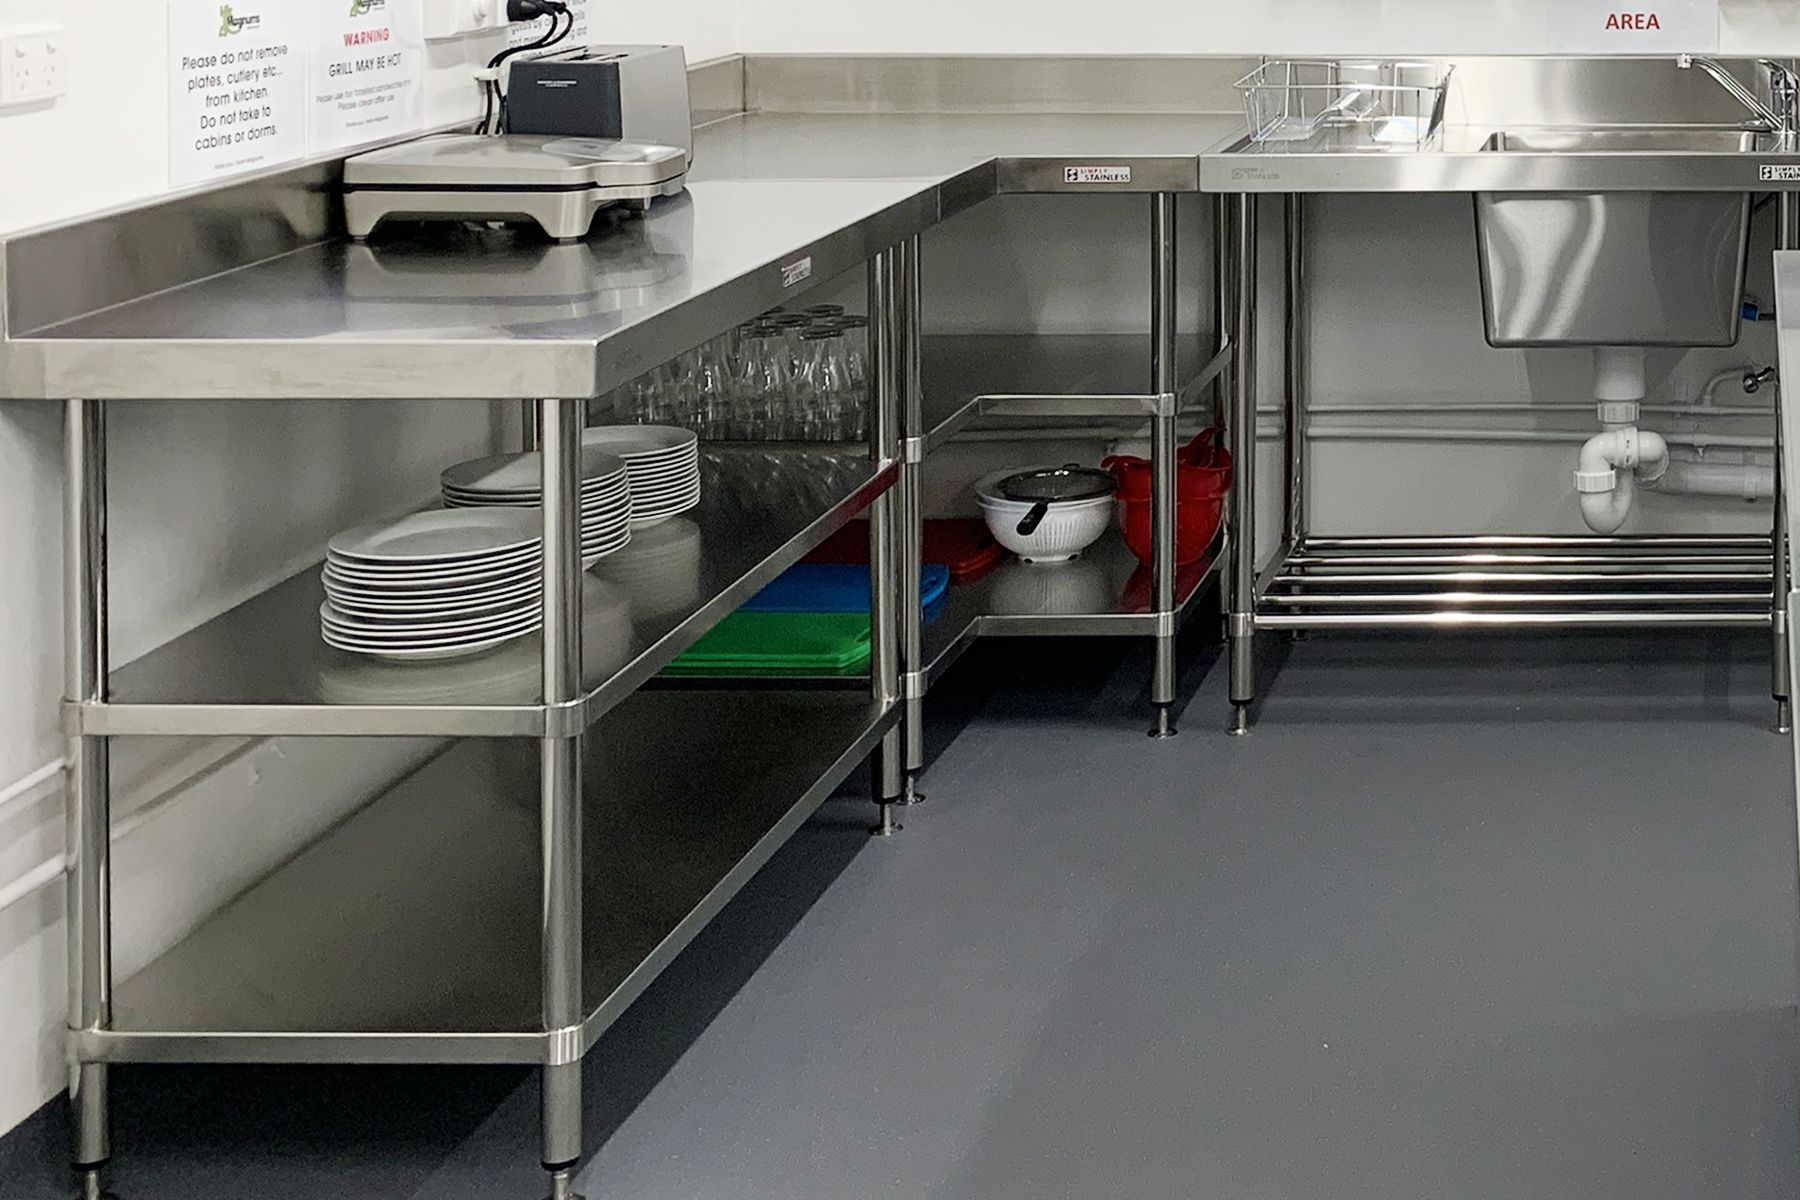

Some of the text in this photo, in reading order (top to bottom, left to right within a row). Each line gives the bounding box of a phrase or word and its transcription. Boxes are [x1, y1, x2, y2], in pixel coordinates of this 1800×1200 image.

[1605, 14, 1660, 30] AREA
[343, 28, 390, 47] WARNING
[182, 44, 288, 71] Please do not remove
[328, 53, 402, 77] GRILL MAY BE HOT
[188, 72, 225, 93] plates,
[227, 68, 259, 85] cutlery
[206, 86, 269, 108] from kitchen.
[200, 105, 272, 130] Do not take to
[195, 124, 278, 151] cabins or dorms.
